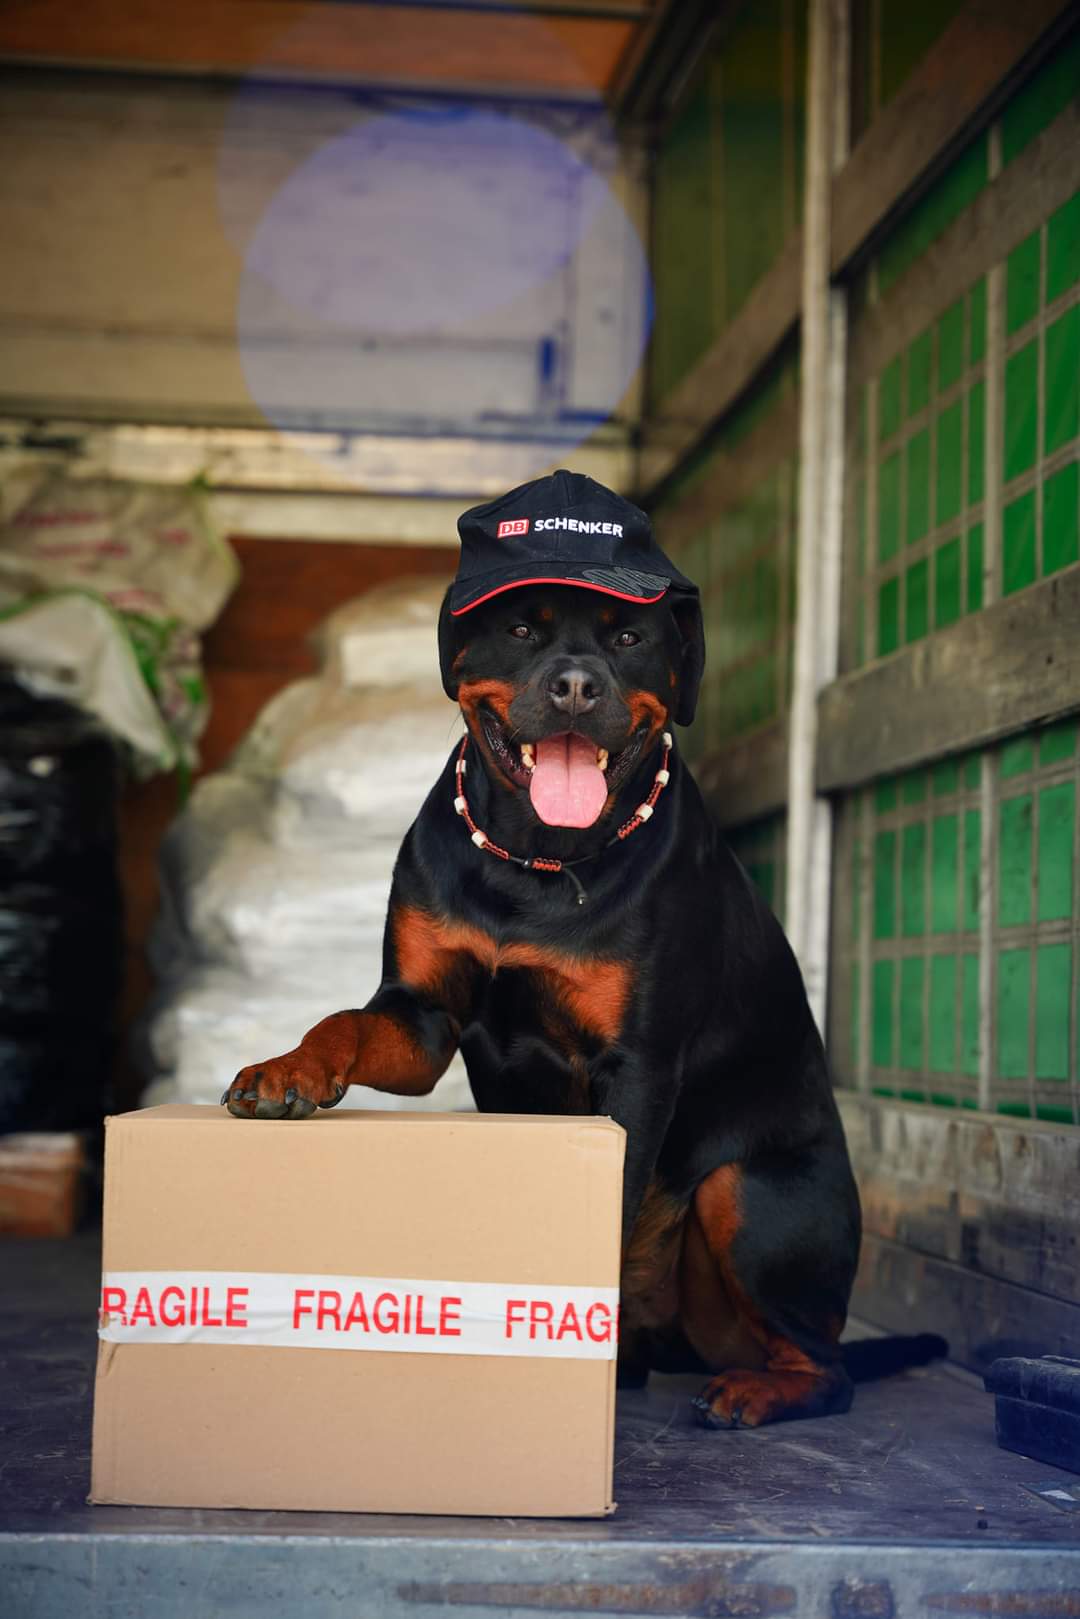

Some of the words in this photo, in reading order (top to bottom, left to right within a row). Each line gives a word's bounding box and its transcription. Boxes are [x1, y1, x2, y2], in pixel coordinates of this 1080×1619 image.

[499, 520, 528, 537] DB
[534, 517, 624, 539] SCHENKER
[292, 1288, 463, 1337] FRAGILE
